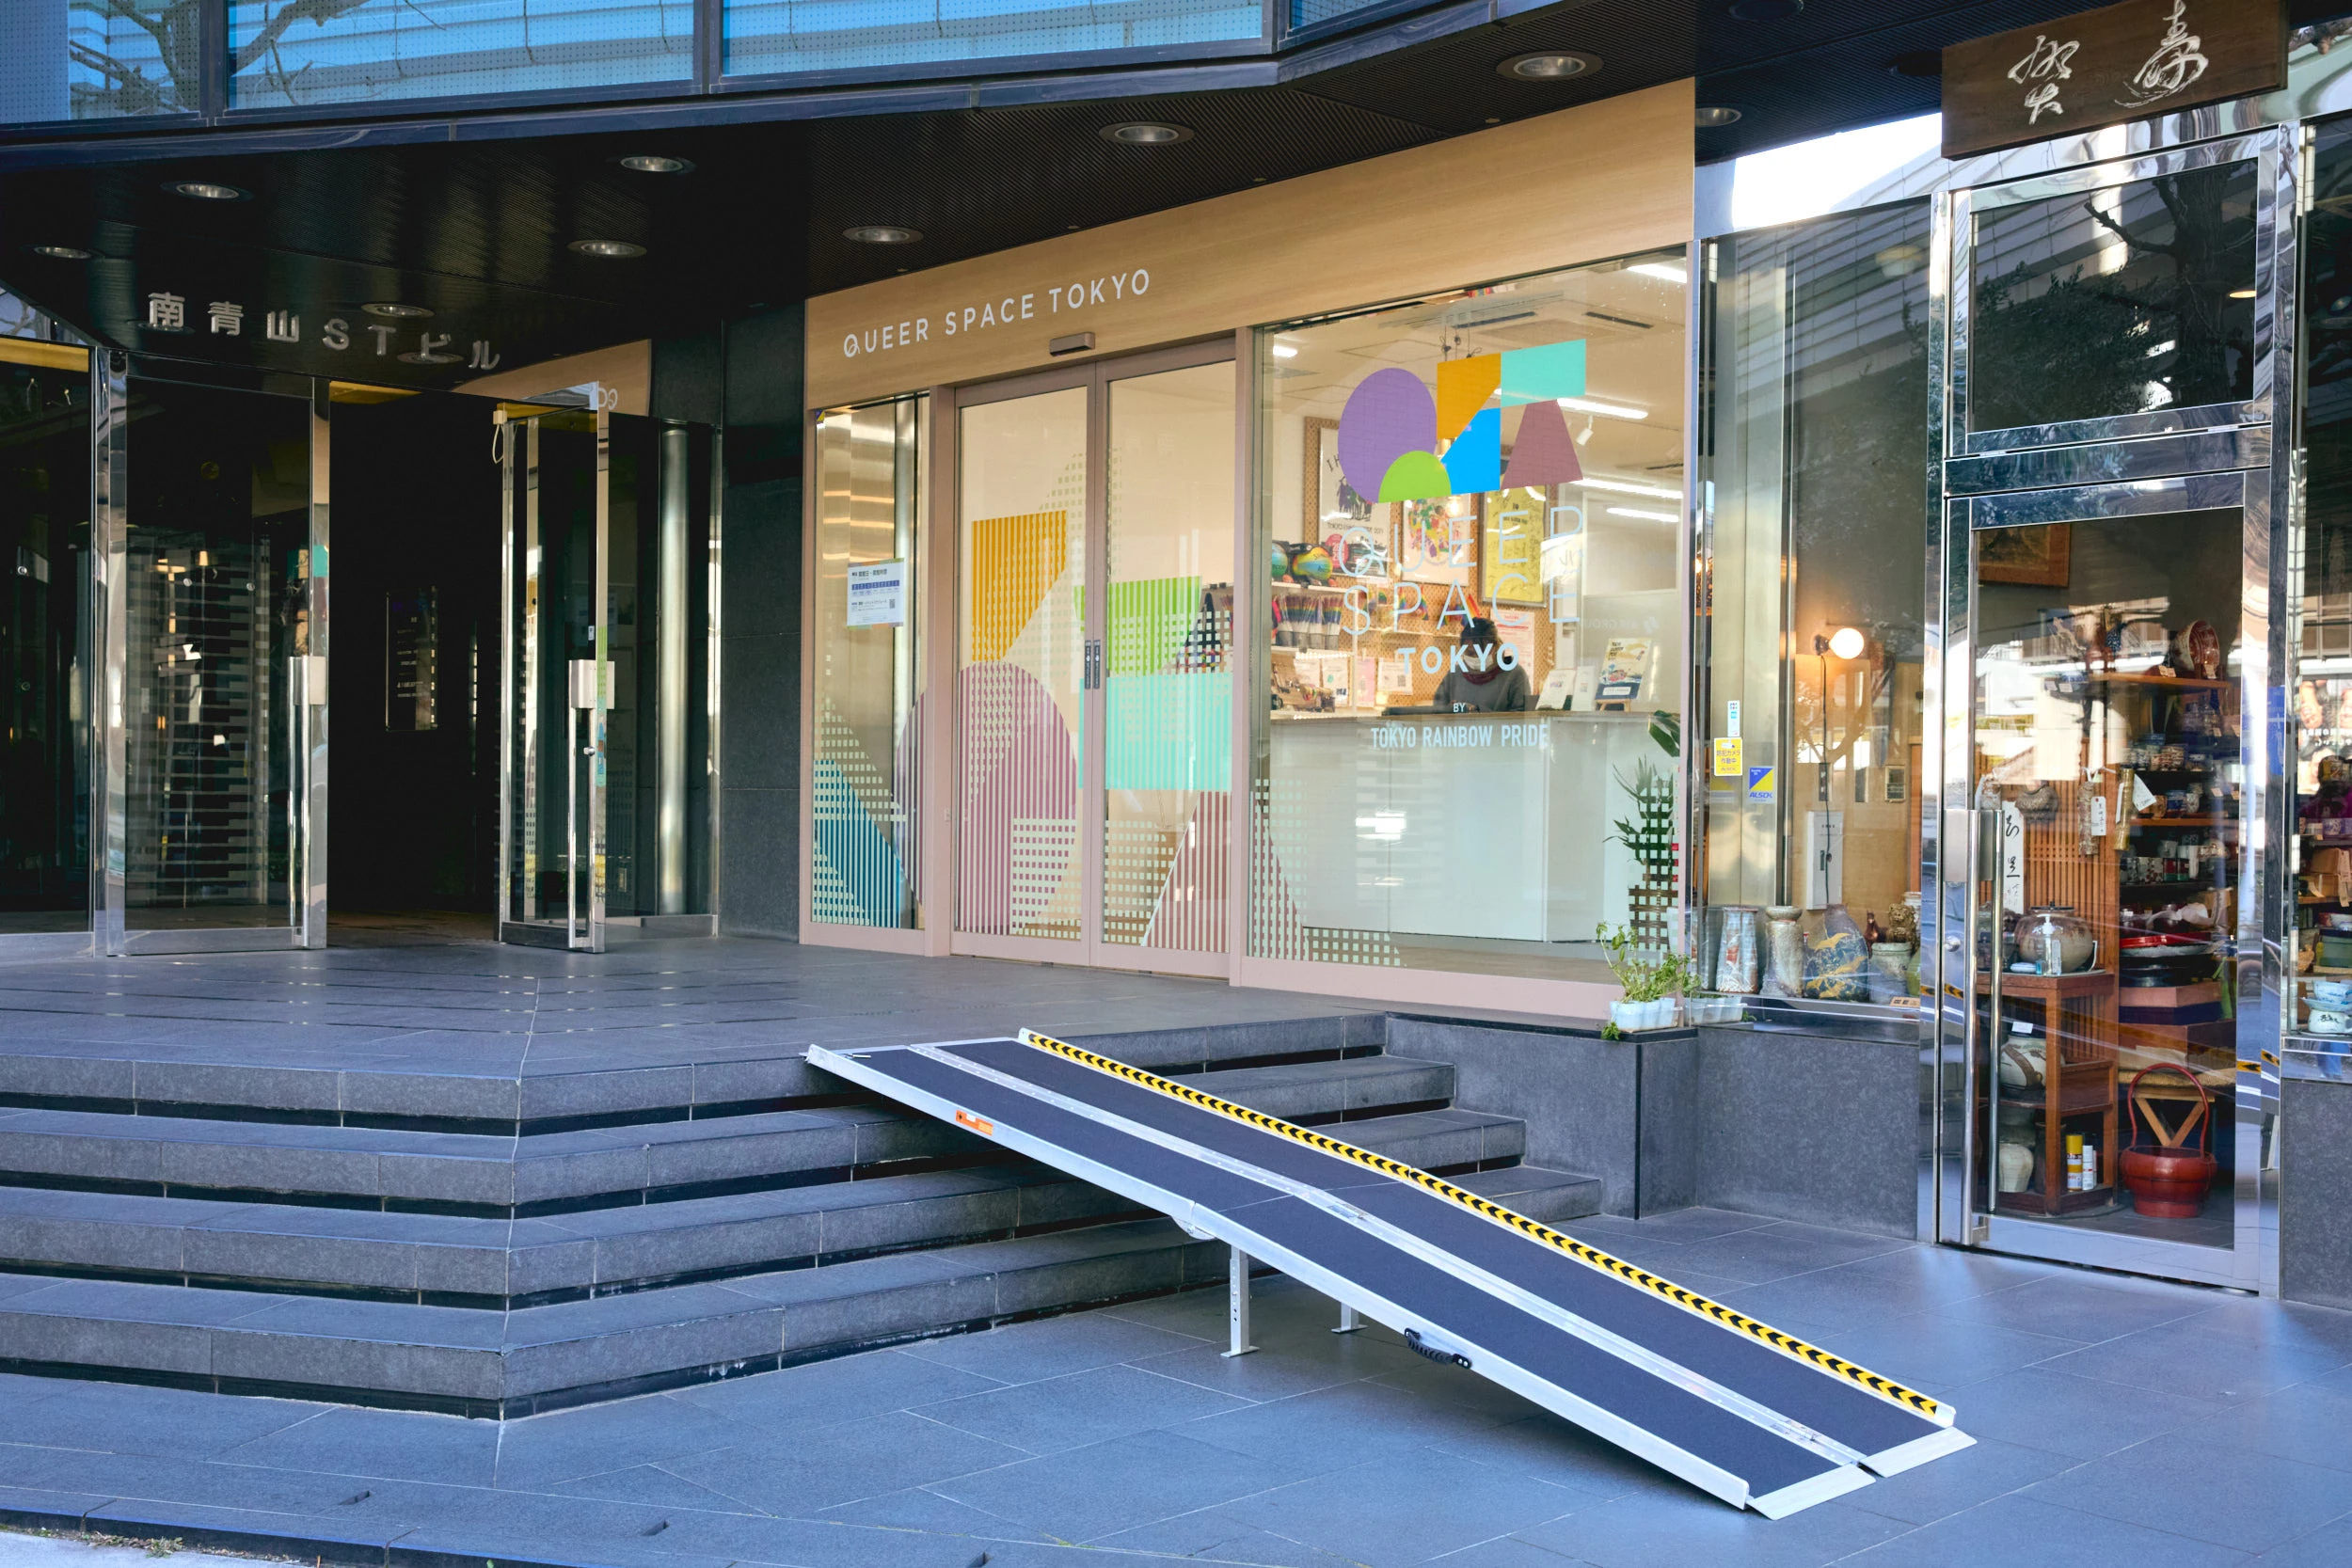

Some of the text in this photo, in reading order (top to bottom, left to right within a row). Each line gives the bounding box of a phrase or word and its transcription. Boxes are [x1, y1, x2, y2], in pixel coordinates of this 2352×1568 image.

[148, 292, 501, 372] 南青山STビル
[843, 268, 1150, 358] QUEER SPACE TOKYO
[1338, 505, 1583, 578] QUEER
[1342, 569, 1581, 636] SPACE
[1398, 641, 1519, 674] TOKYO
[1371, 723, 1549, 749] TOKYO RAINBOW PRIDE
[1453, 703, 1466, 714] BY
